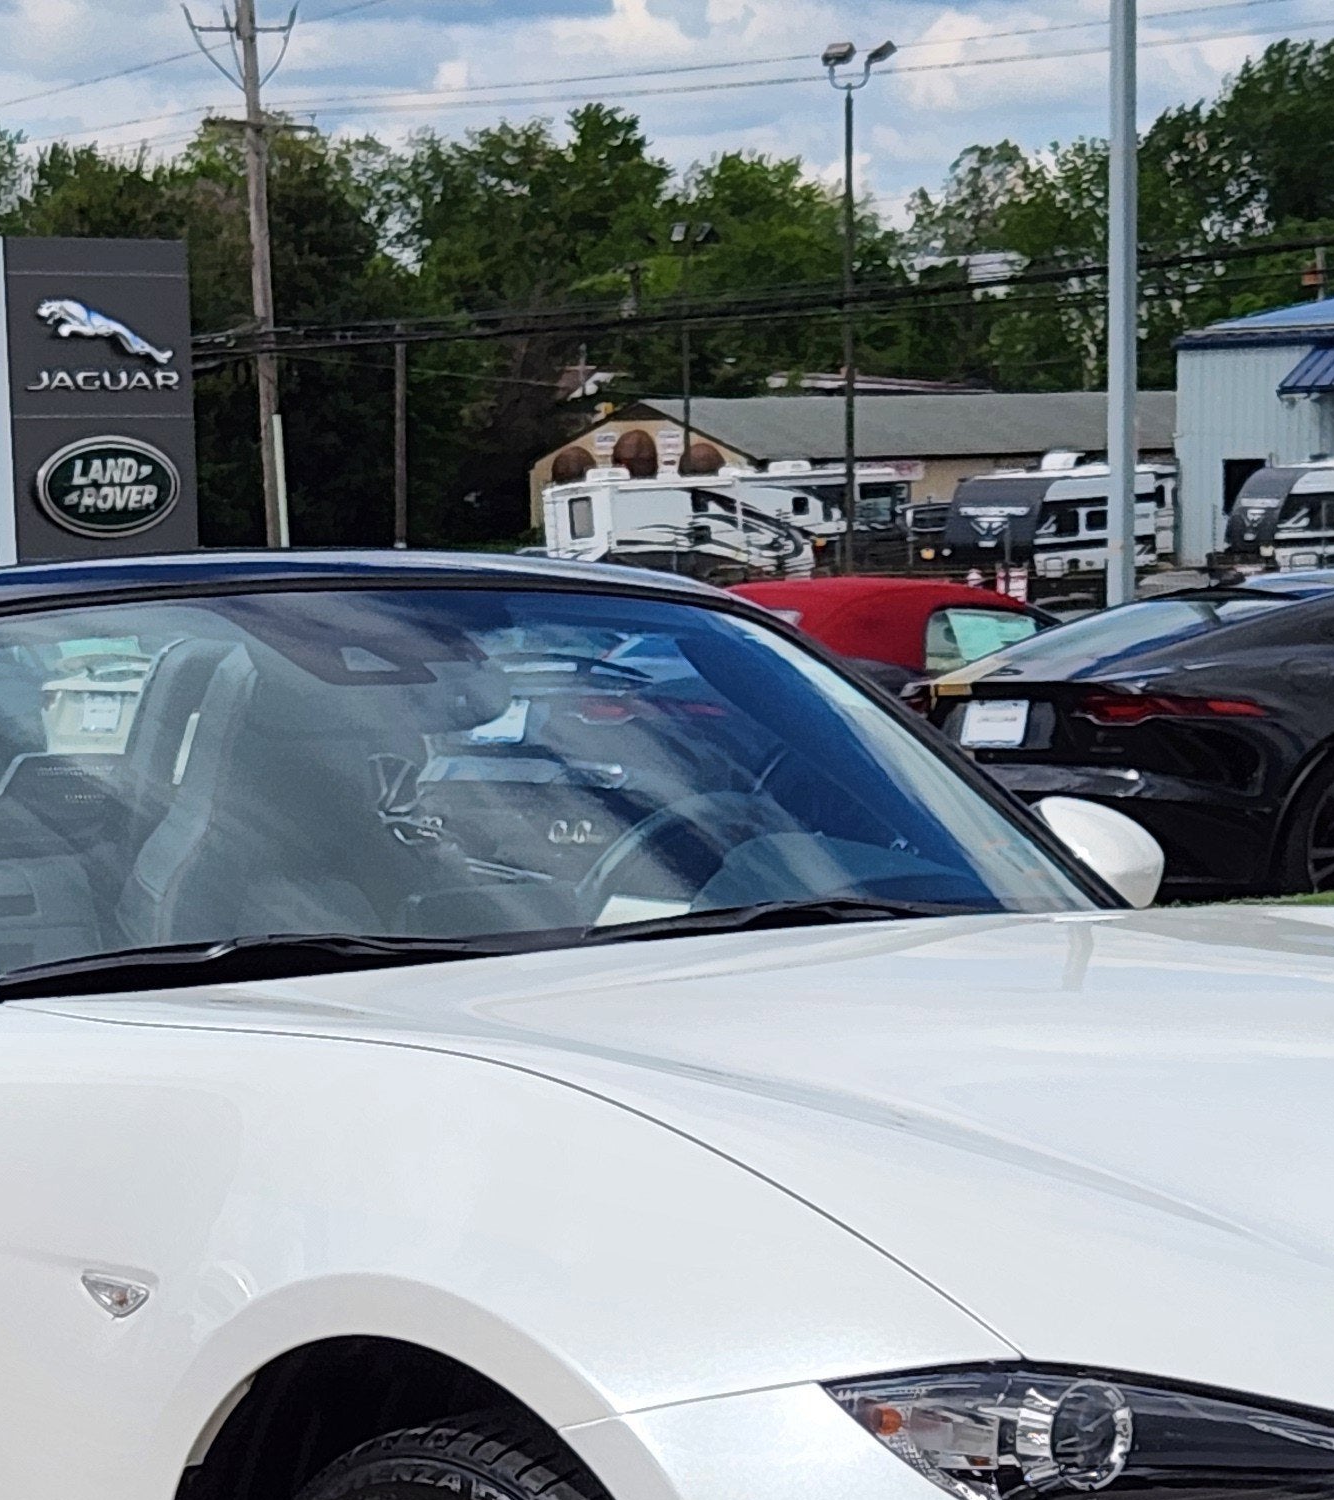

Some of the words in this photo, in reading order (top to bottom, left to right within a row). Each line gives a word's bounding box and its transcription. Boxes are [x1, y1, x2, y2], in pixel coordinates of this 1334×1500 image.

[27, 371, 179, 390] JAGUAR
[71, 457, 138, 485] LAND
[78, 484, 158, 513] ROVER
